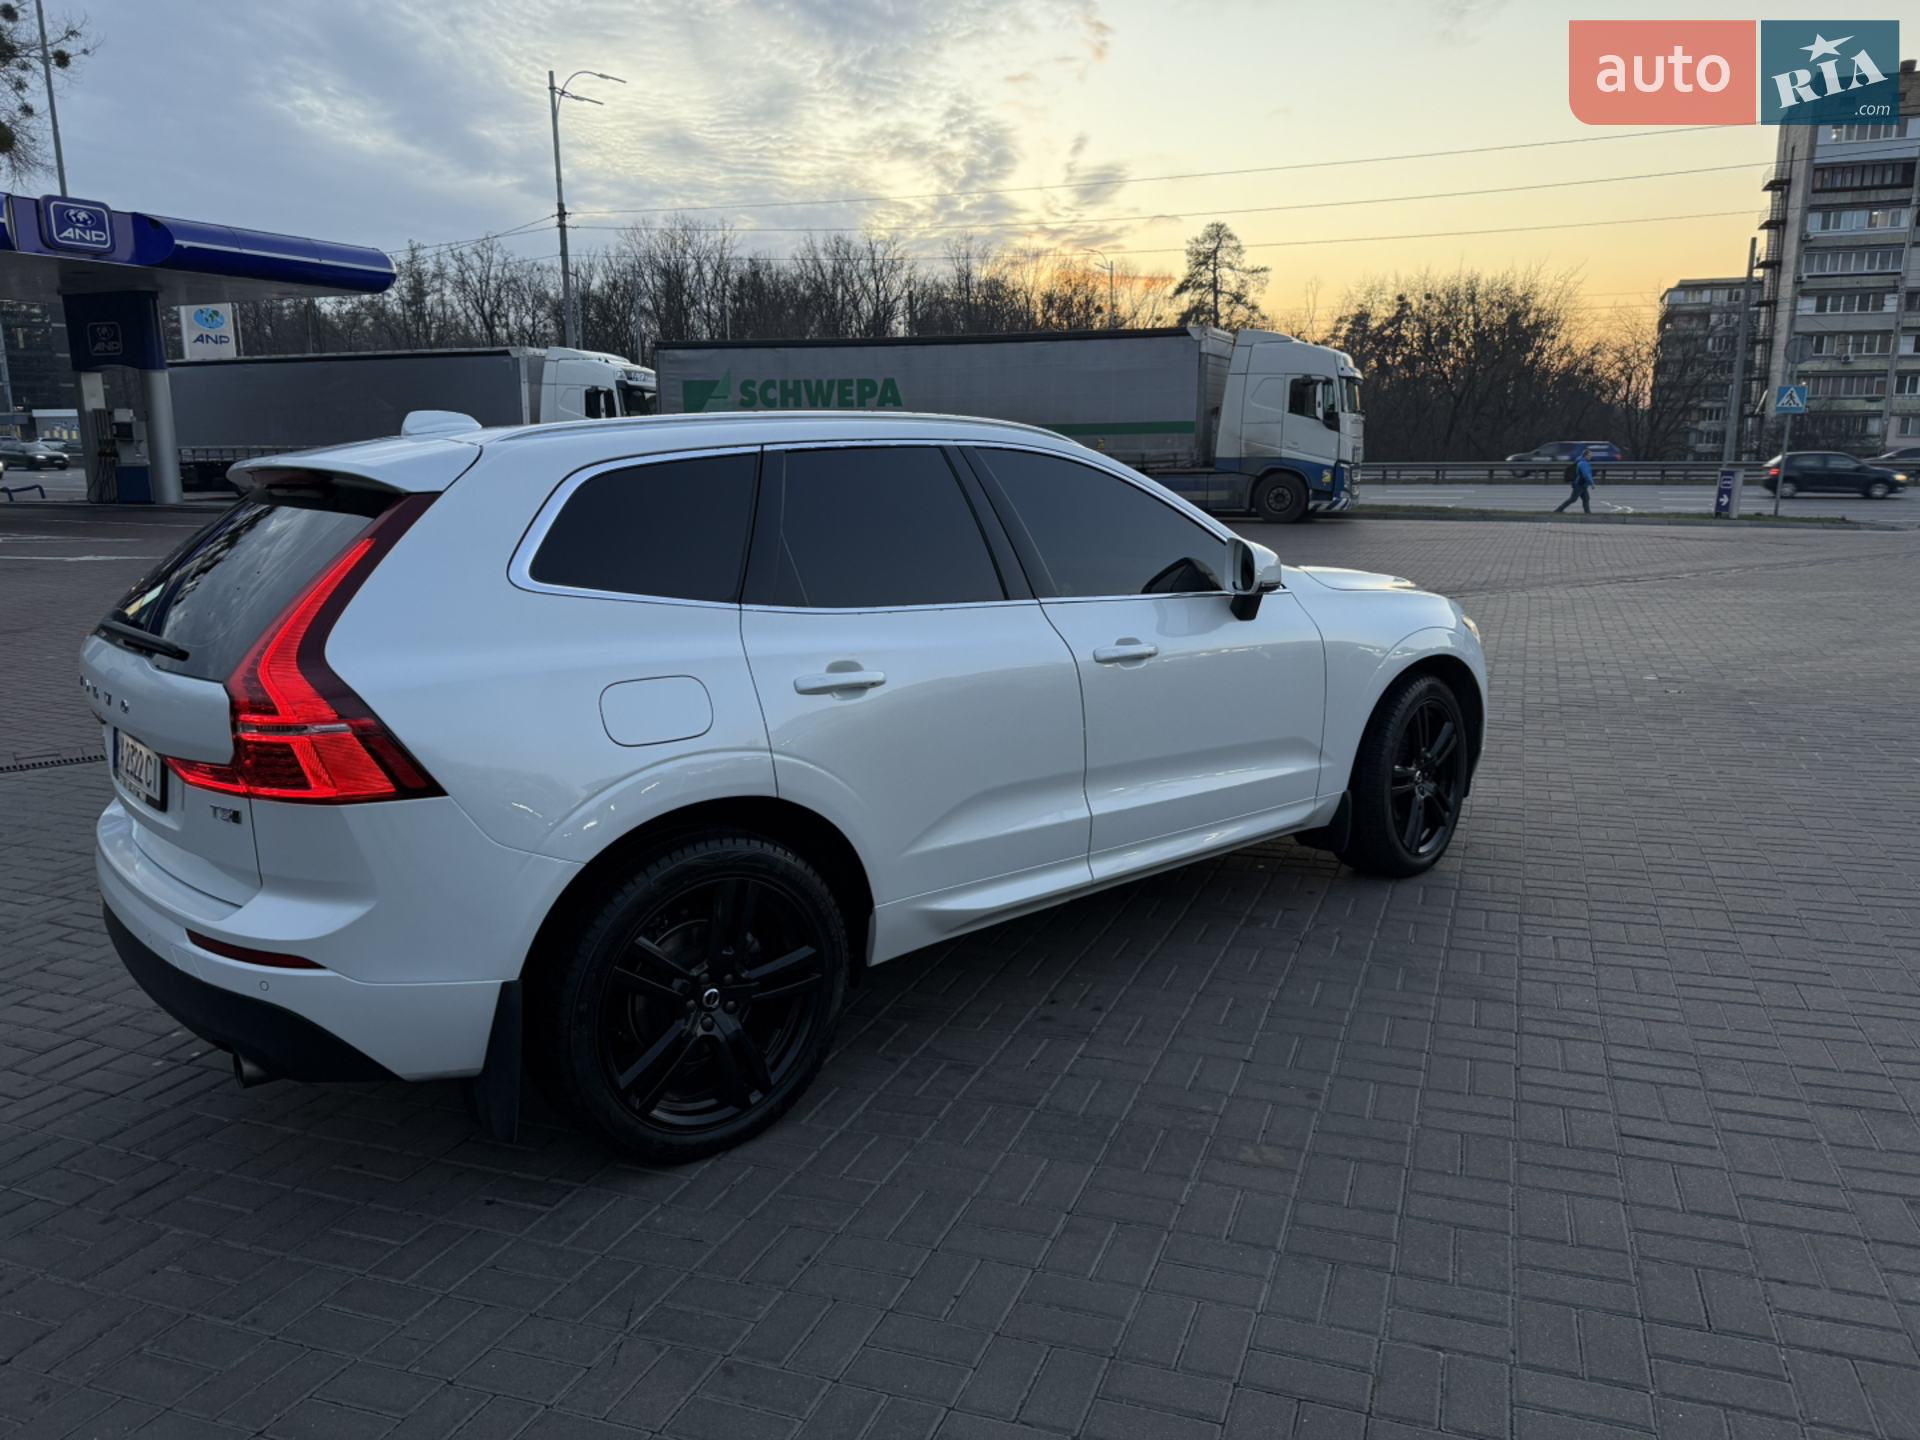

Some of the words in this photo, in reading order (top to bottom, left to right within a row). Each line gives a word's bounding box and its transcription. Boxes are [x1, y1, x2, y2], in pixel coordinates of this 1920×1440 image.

[58, 227, 107, 242] ANP
[92, 341, 121, 352] ANP
[193, 333, 231, 346] ANP
[738, 377, 904, 409] SCHWEPA
